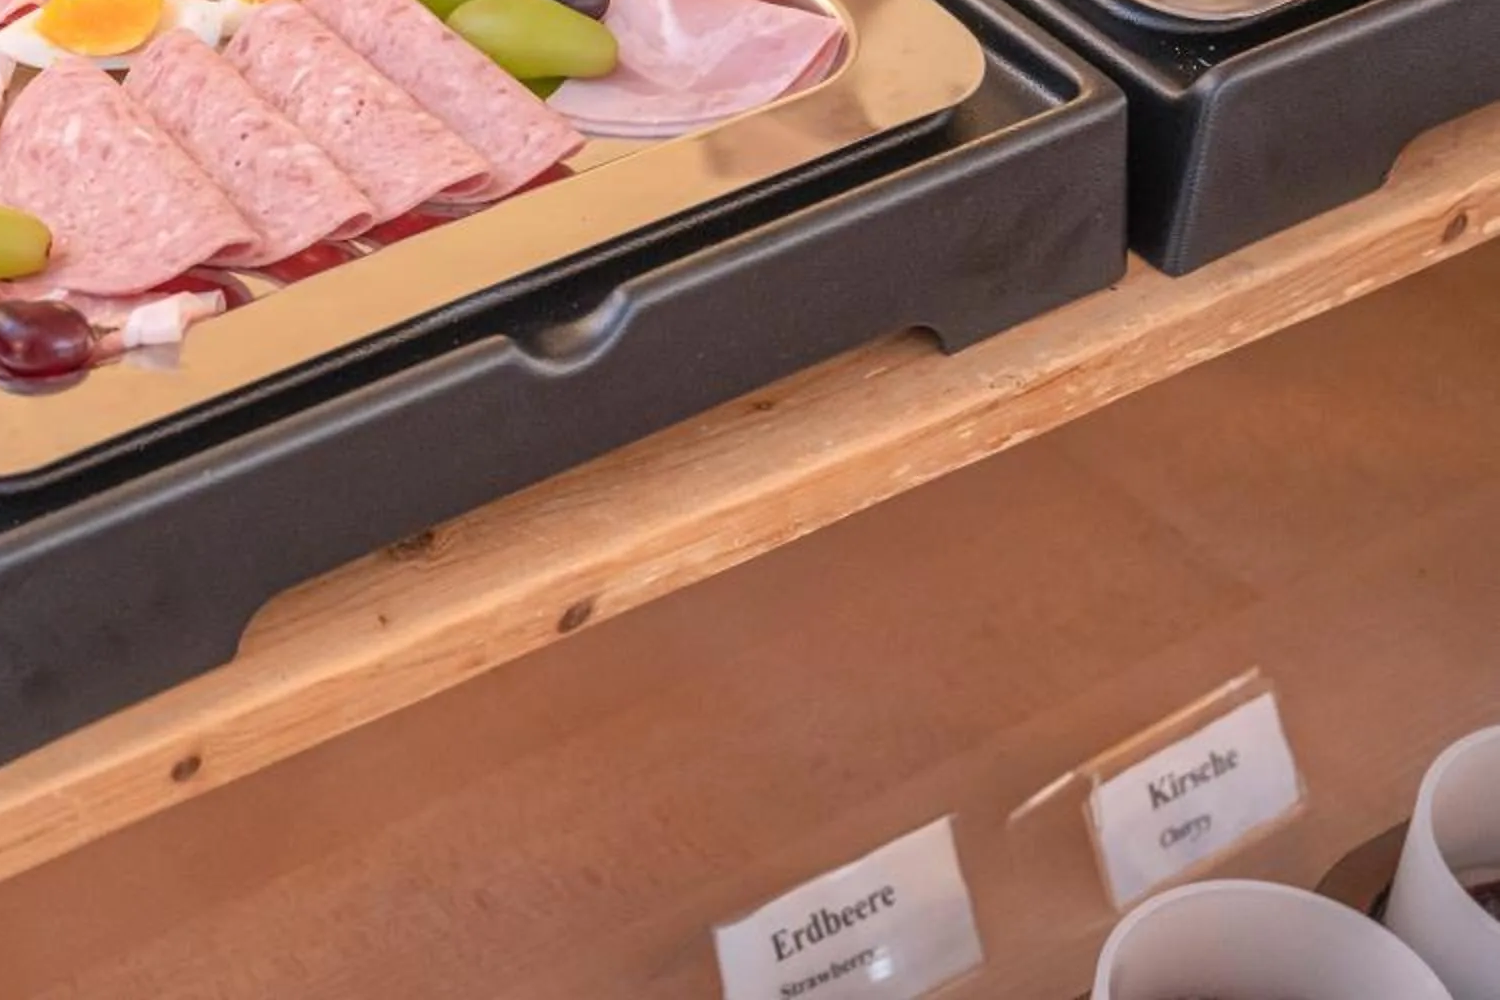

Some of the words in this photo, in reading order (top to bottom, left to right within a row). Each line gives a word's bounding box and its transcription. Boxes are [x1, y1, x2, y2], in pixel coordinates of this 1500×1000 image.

[1147, 748, 1241, 811] Kirsche
[769, 883, 898, 963] Erdbeere
[778, 946, 877, 1000] Strawberry
